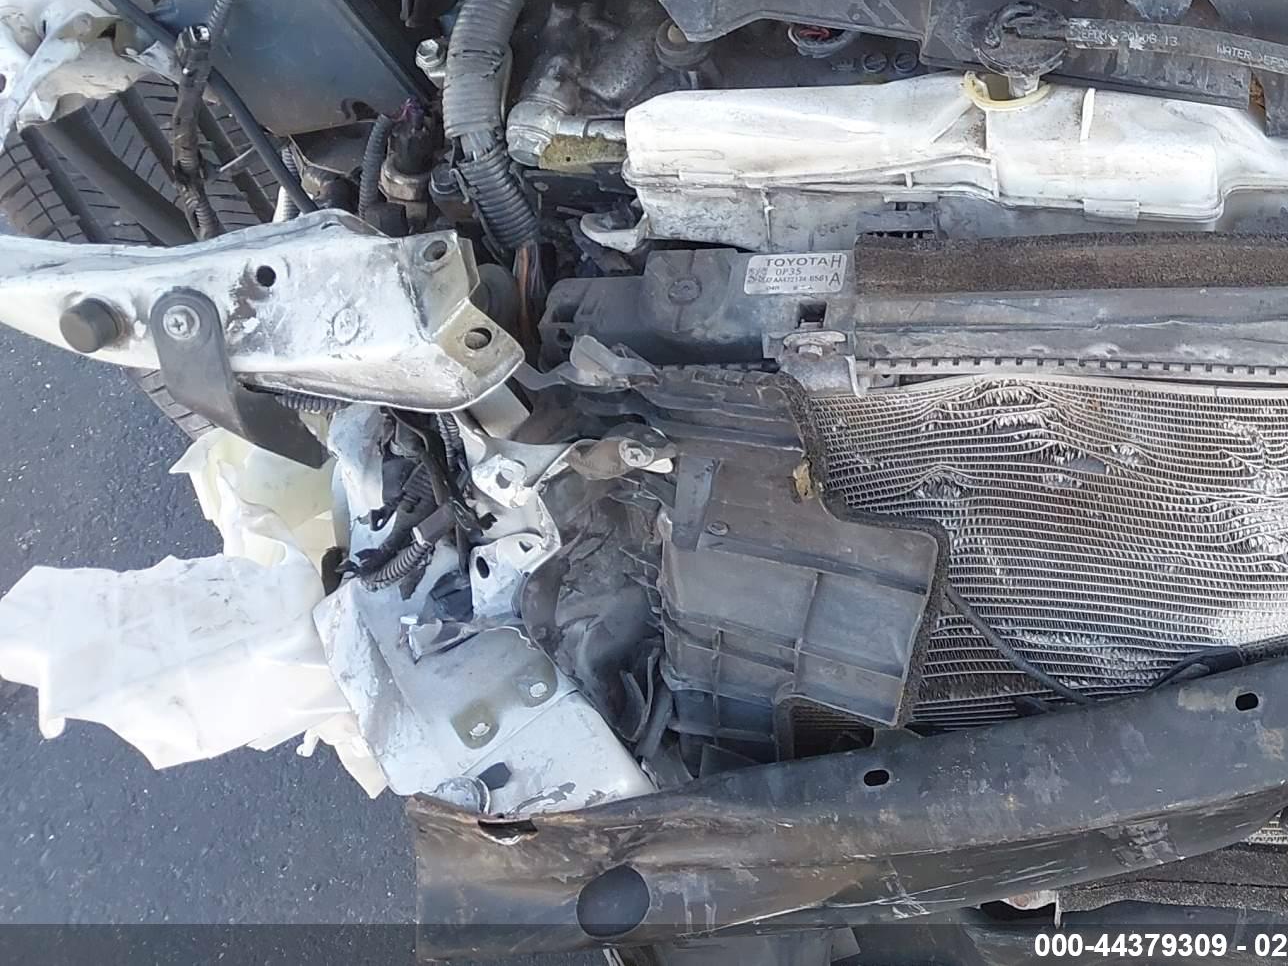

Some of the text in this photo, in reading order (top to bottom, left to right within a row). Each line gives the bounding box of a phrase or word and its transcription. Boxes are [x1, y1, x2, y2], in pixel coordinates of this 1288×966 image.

[1216, 43, 1251, 60] WATER
[766, 254, 842, 268] TOYOTA H
[828, 272, 841, 286] A
